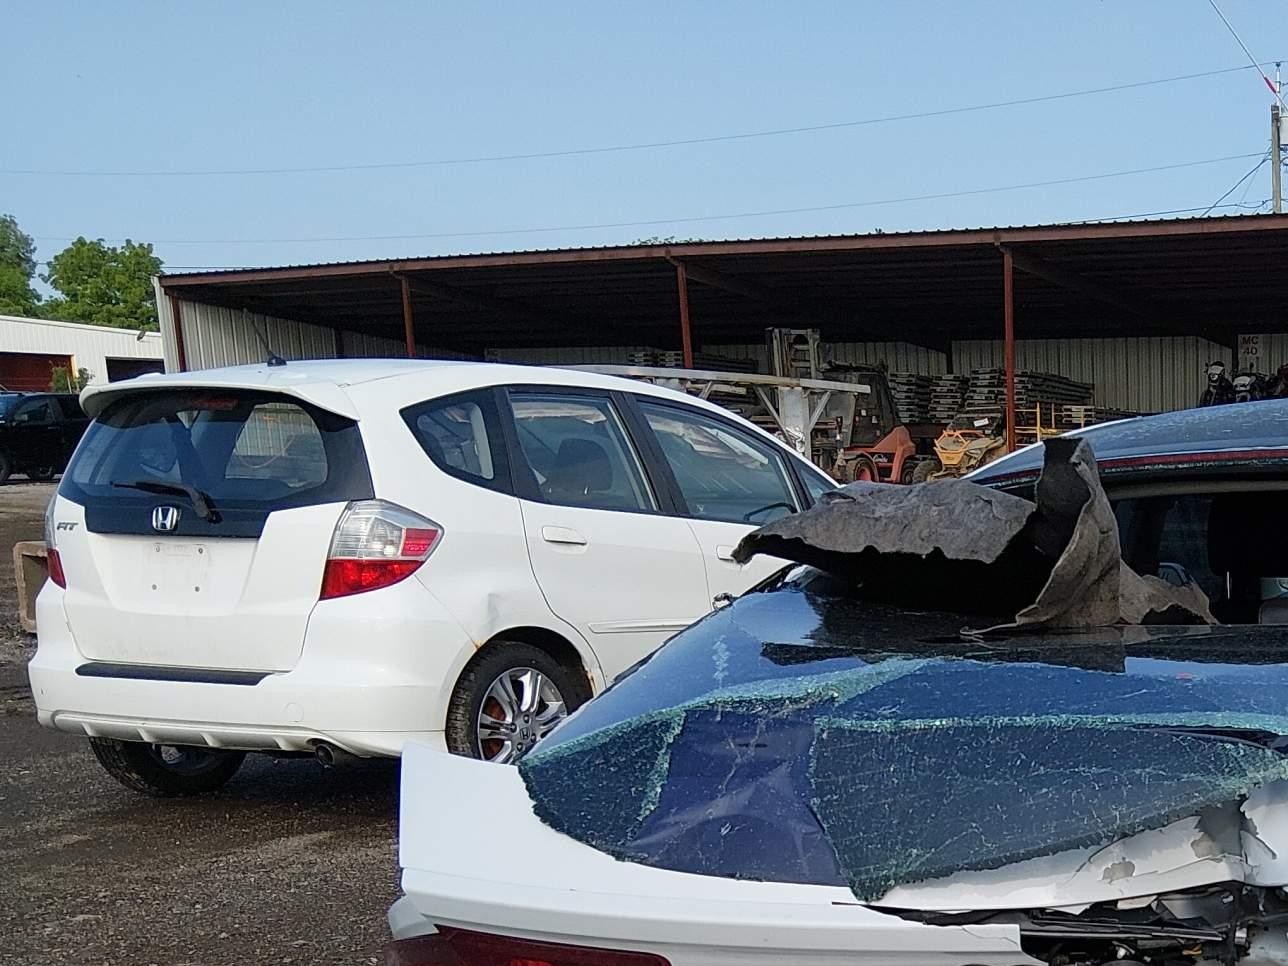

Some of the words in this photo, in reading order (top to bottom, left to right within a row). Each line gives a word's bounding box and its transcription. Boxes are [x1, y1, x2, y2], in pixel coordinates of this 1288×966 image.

[1242, 336, 1259, 345] MC
[1242, 346, 1258, 355] 40
[56, 522, 79, 531] FIT
